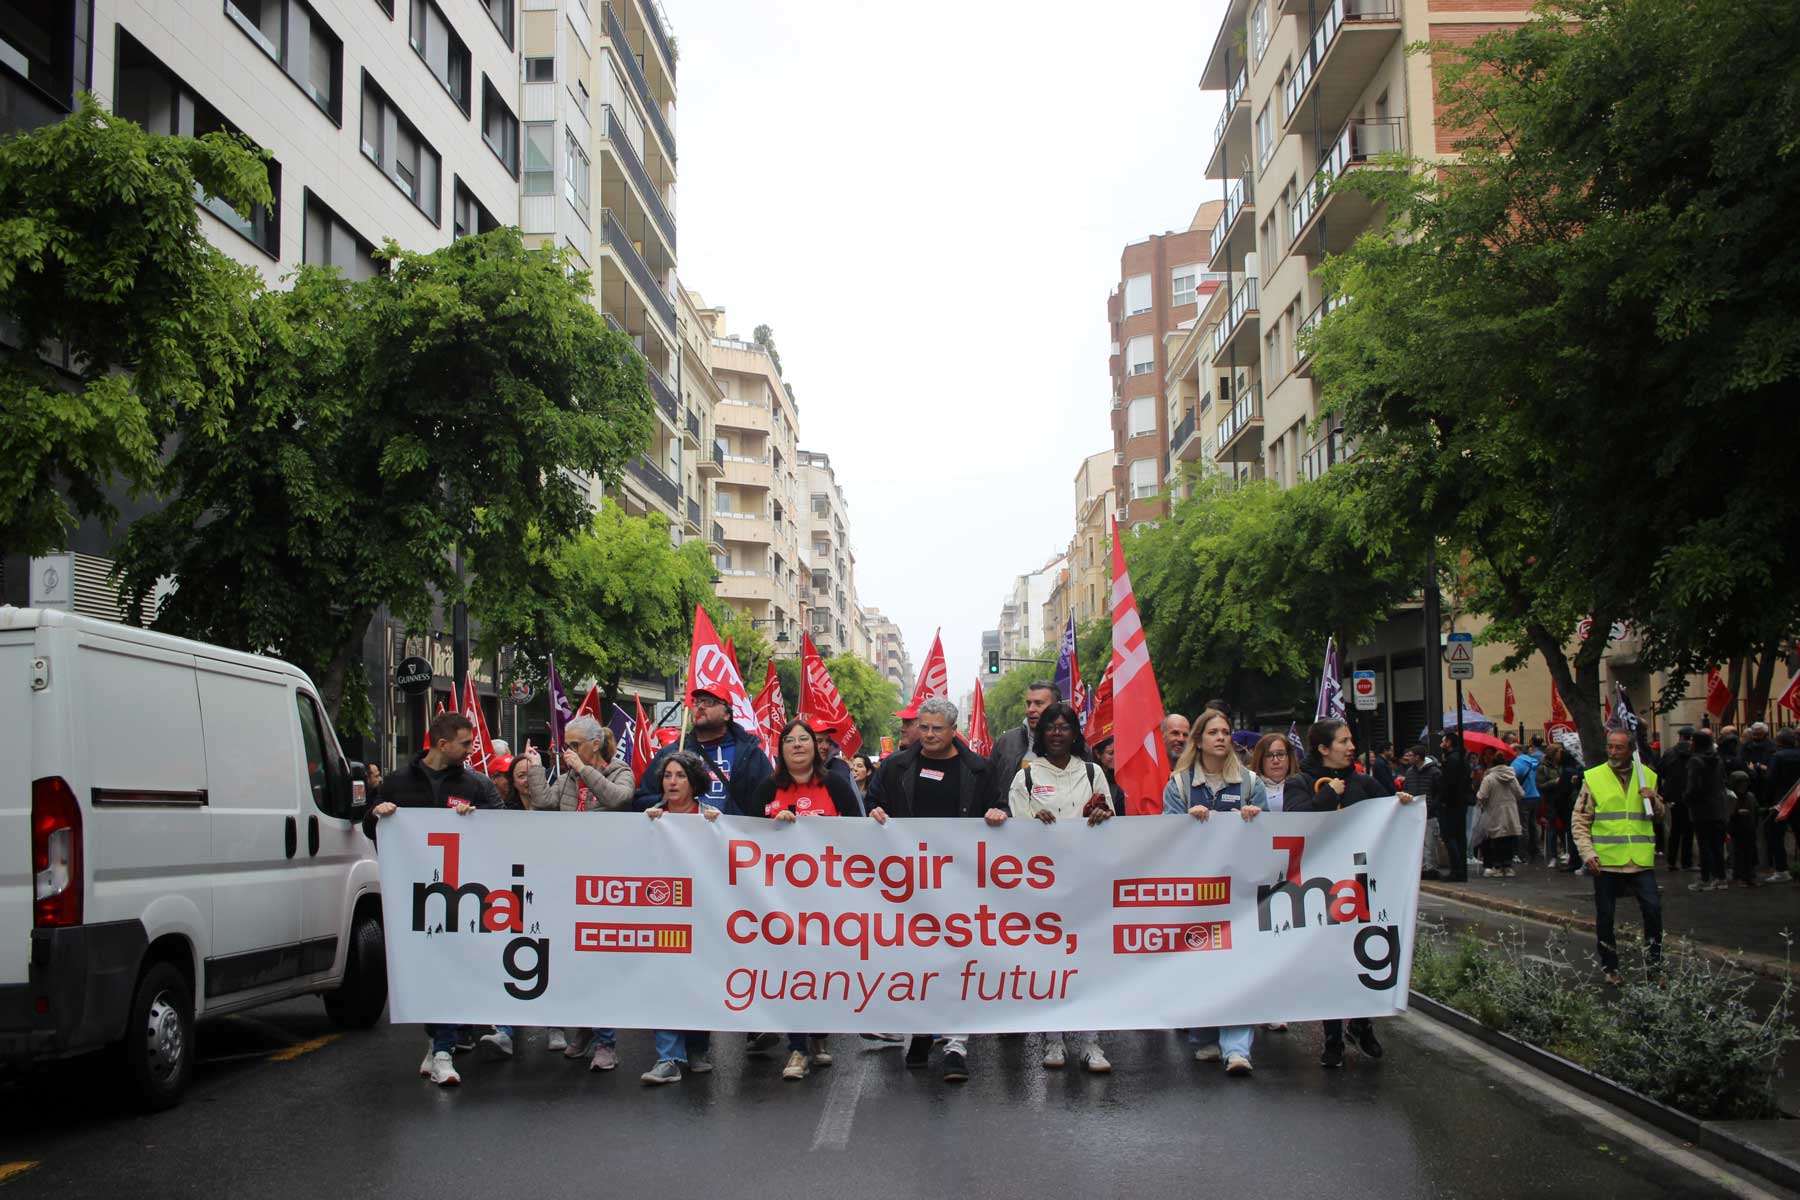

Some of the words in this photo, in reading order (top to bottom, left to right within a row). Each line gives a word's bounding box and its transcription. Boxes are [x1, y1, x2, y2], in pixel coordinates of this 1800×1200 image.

[398, 673, 431, 685] GUINNESS
[428, 833, 460, 891] 1
[729, 840, 953, 902] Protegir
[977, 842, 1055, 889] les
[1273, 836, 1305, 887] 1
[585, 880, 642, 904] UGT
[1119, 884, 1194, 901] CCOO
[581, 929, 655, 947] CCOO
[727, 905, 1079, 962] conquestes,
[1123, 928, 1181, 951] UGT
[725, 966, 939, 1012] guanyar
[961, 959, 1079, 1001] futur
